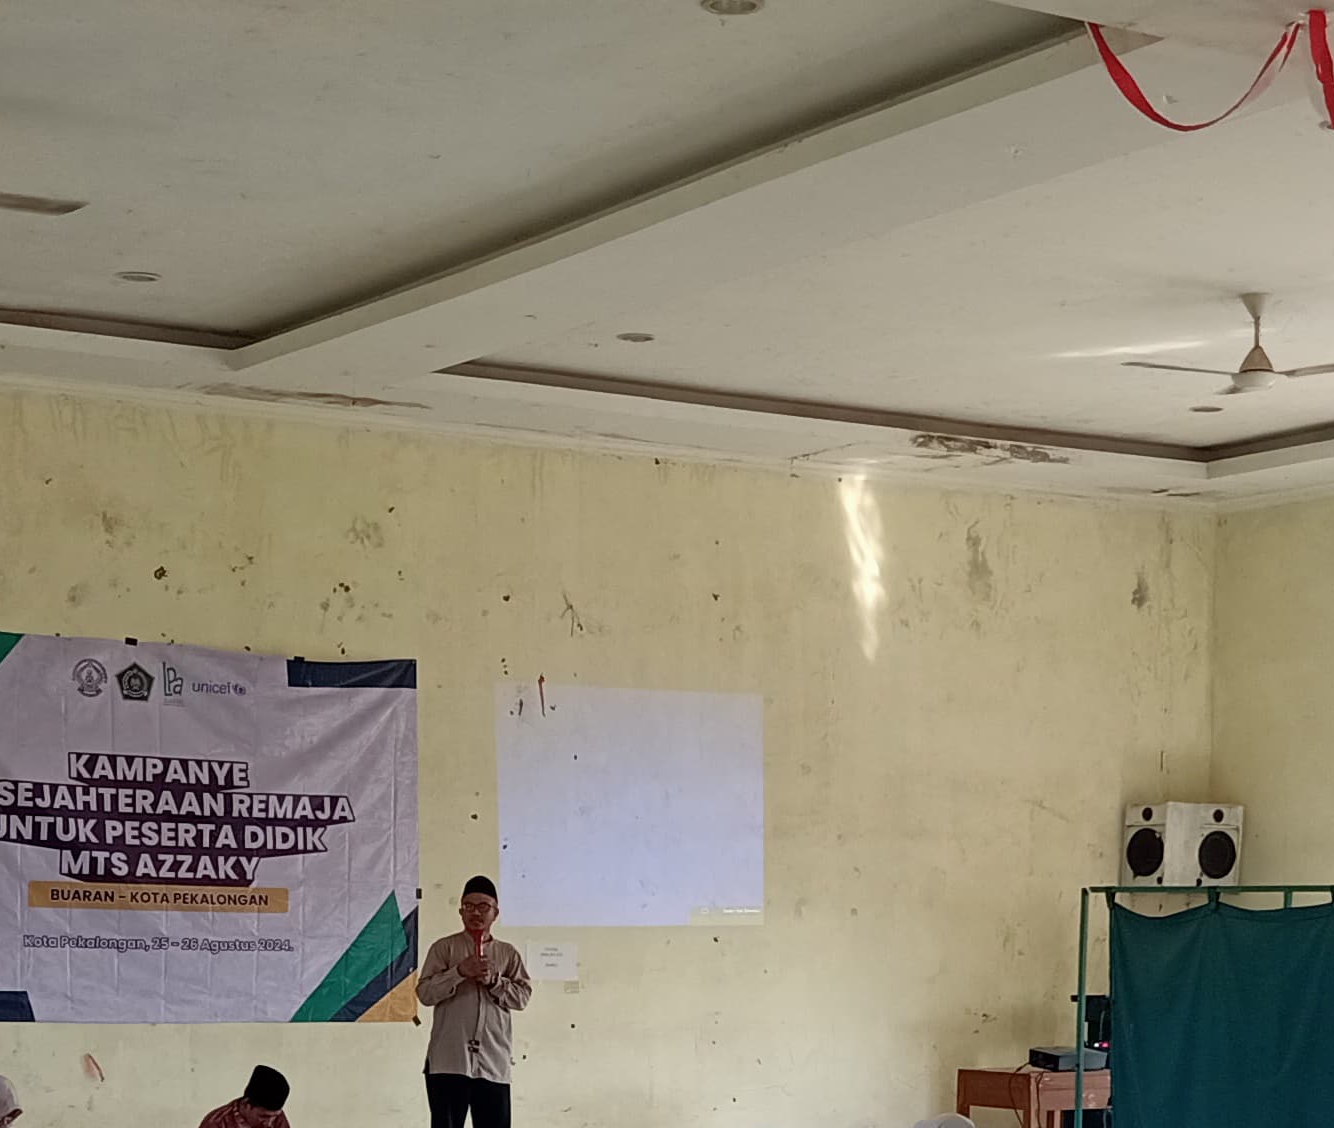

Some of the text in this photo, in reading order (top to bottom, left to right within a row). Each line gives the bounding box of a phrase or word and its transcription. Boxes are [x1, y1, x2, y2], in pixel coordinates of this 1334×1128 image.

[69, 752, 249, 787] KAMPANYE
[231, 793, 354, 821] REMAJA
[104, 819, 238, 849] PESERTA
[244, 825, 328, 851] DIDIK
[61, 849, 260, 881] MTS AZZAKY
[50, 888, 115, 903] BUARAN
[129, 891, 169, 905] KOTA
[173, 892, 269, 906] PEKALONGAN
[23, 935, 58, 948] Kota
[59, 936, 150, 953] Pekalongan,
[151, 937, 169, 950] 25
[181, 938, 199, 951] 26
[200, 938, 257, 955] Agustus
[257, 939, 294, 952] 2024.
